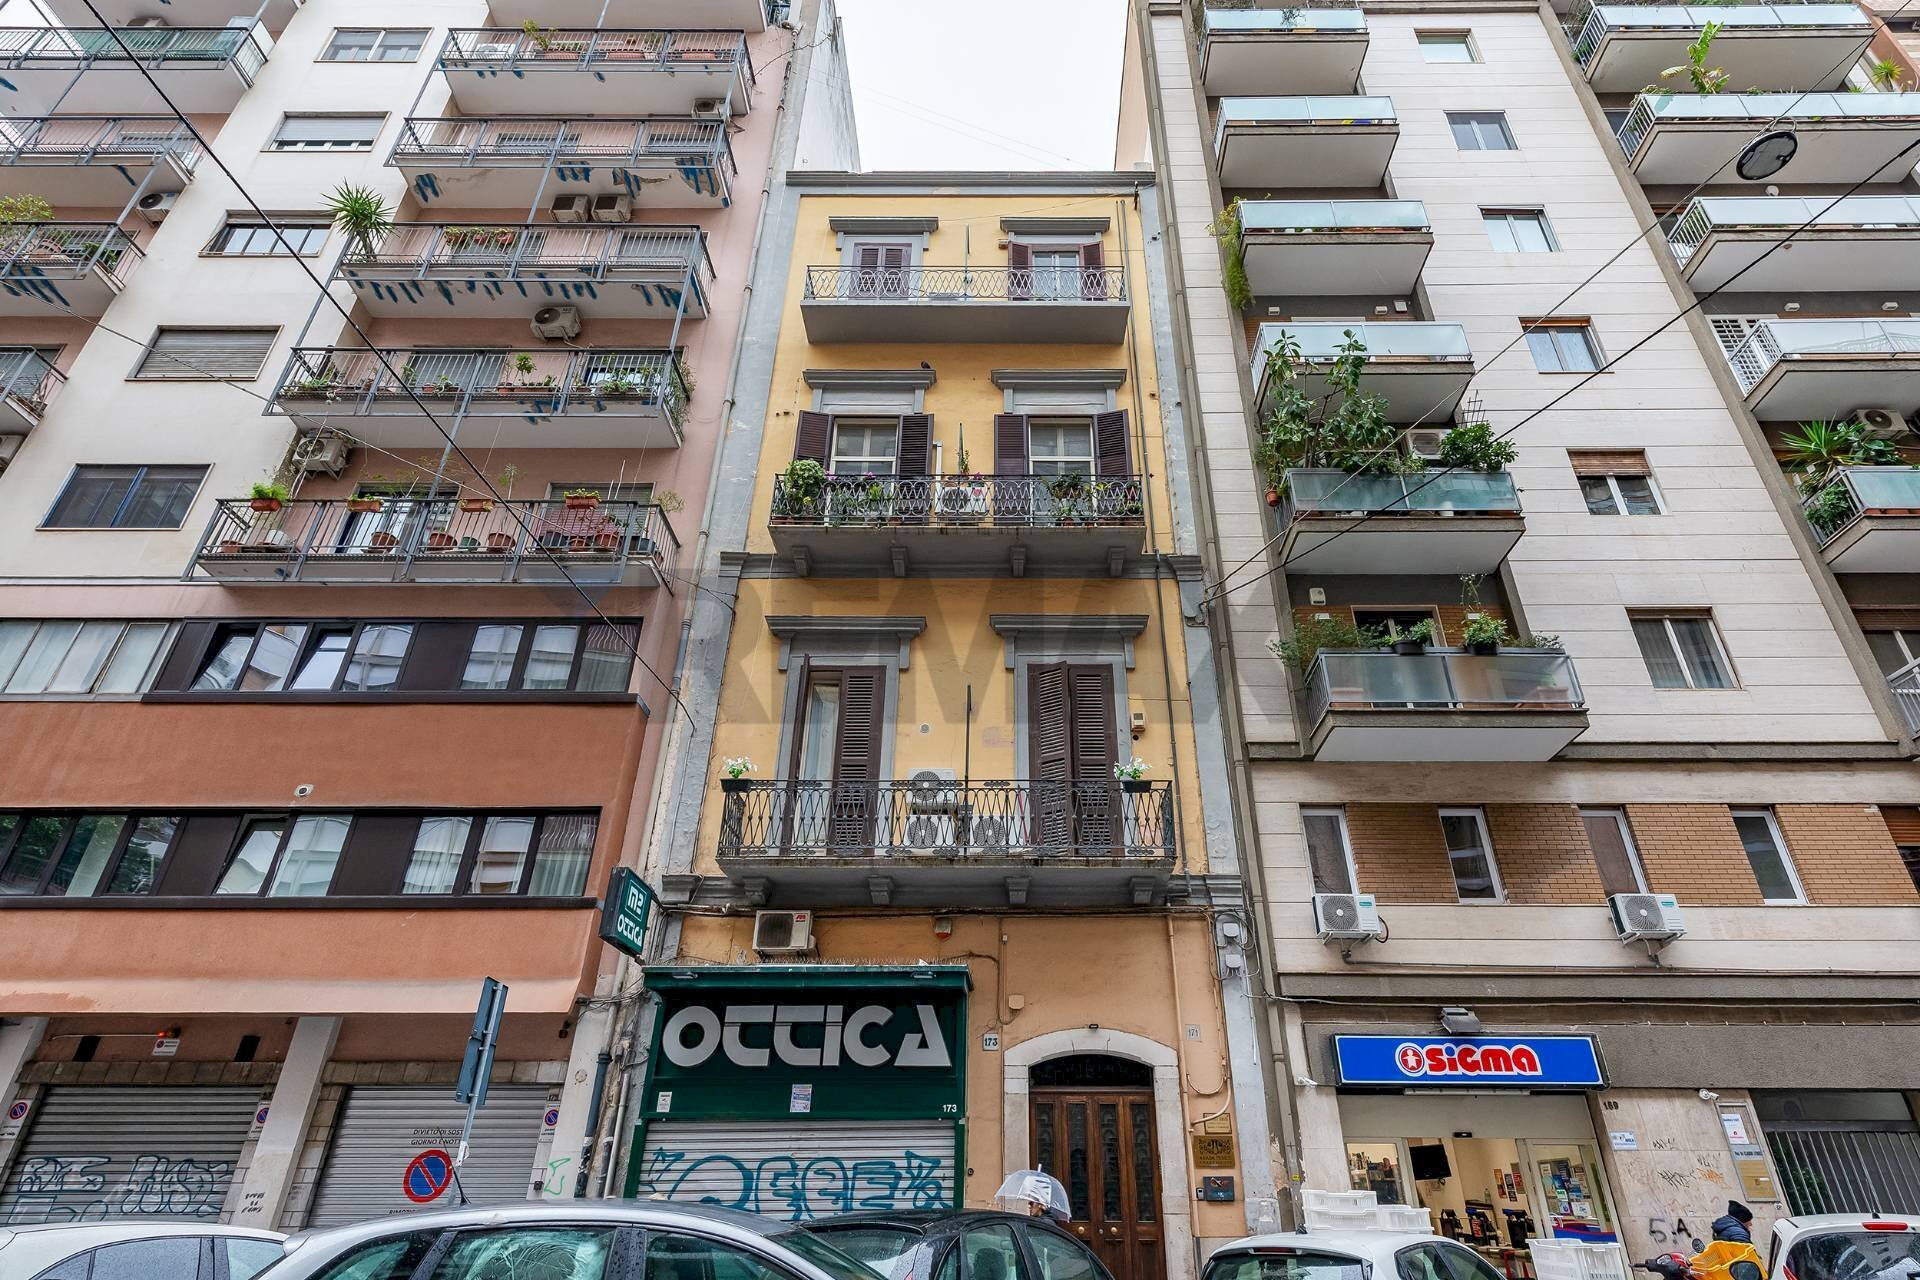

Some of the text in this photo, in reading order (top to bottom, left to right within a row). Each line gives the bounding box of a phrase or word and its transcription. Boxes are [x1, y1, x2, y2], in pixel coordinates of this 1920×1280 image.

[617, 913, 643, 947] OTTICA
[662, 1004, 952, 1068] OTTICA
[1188, 1028, 1199, 1037] 171
[984, 1037, 998, 1047] 173
[942, 1104, 957, 1113] 173
[1603, 1101, 1619, 1111] 169
[411, 1138, 438, 1146] GIORNO
